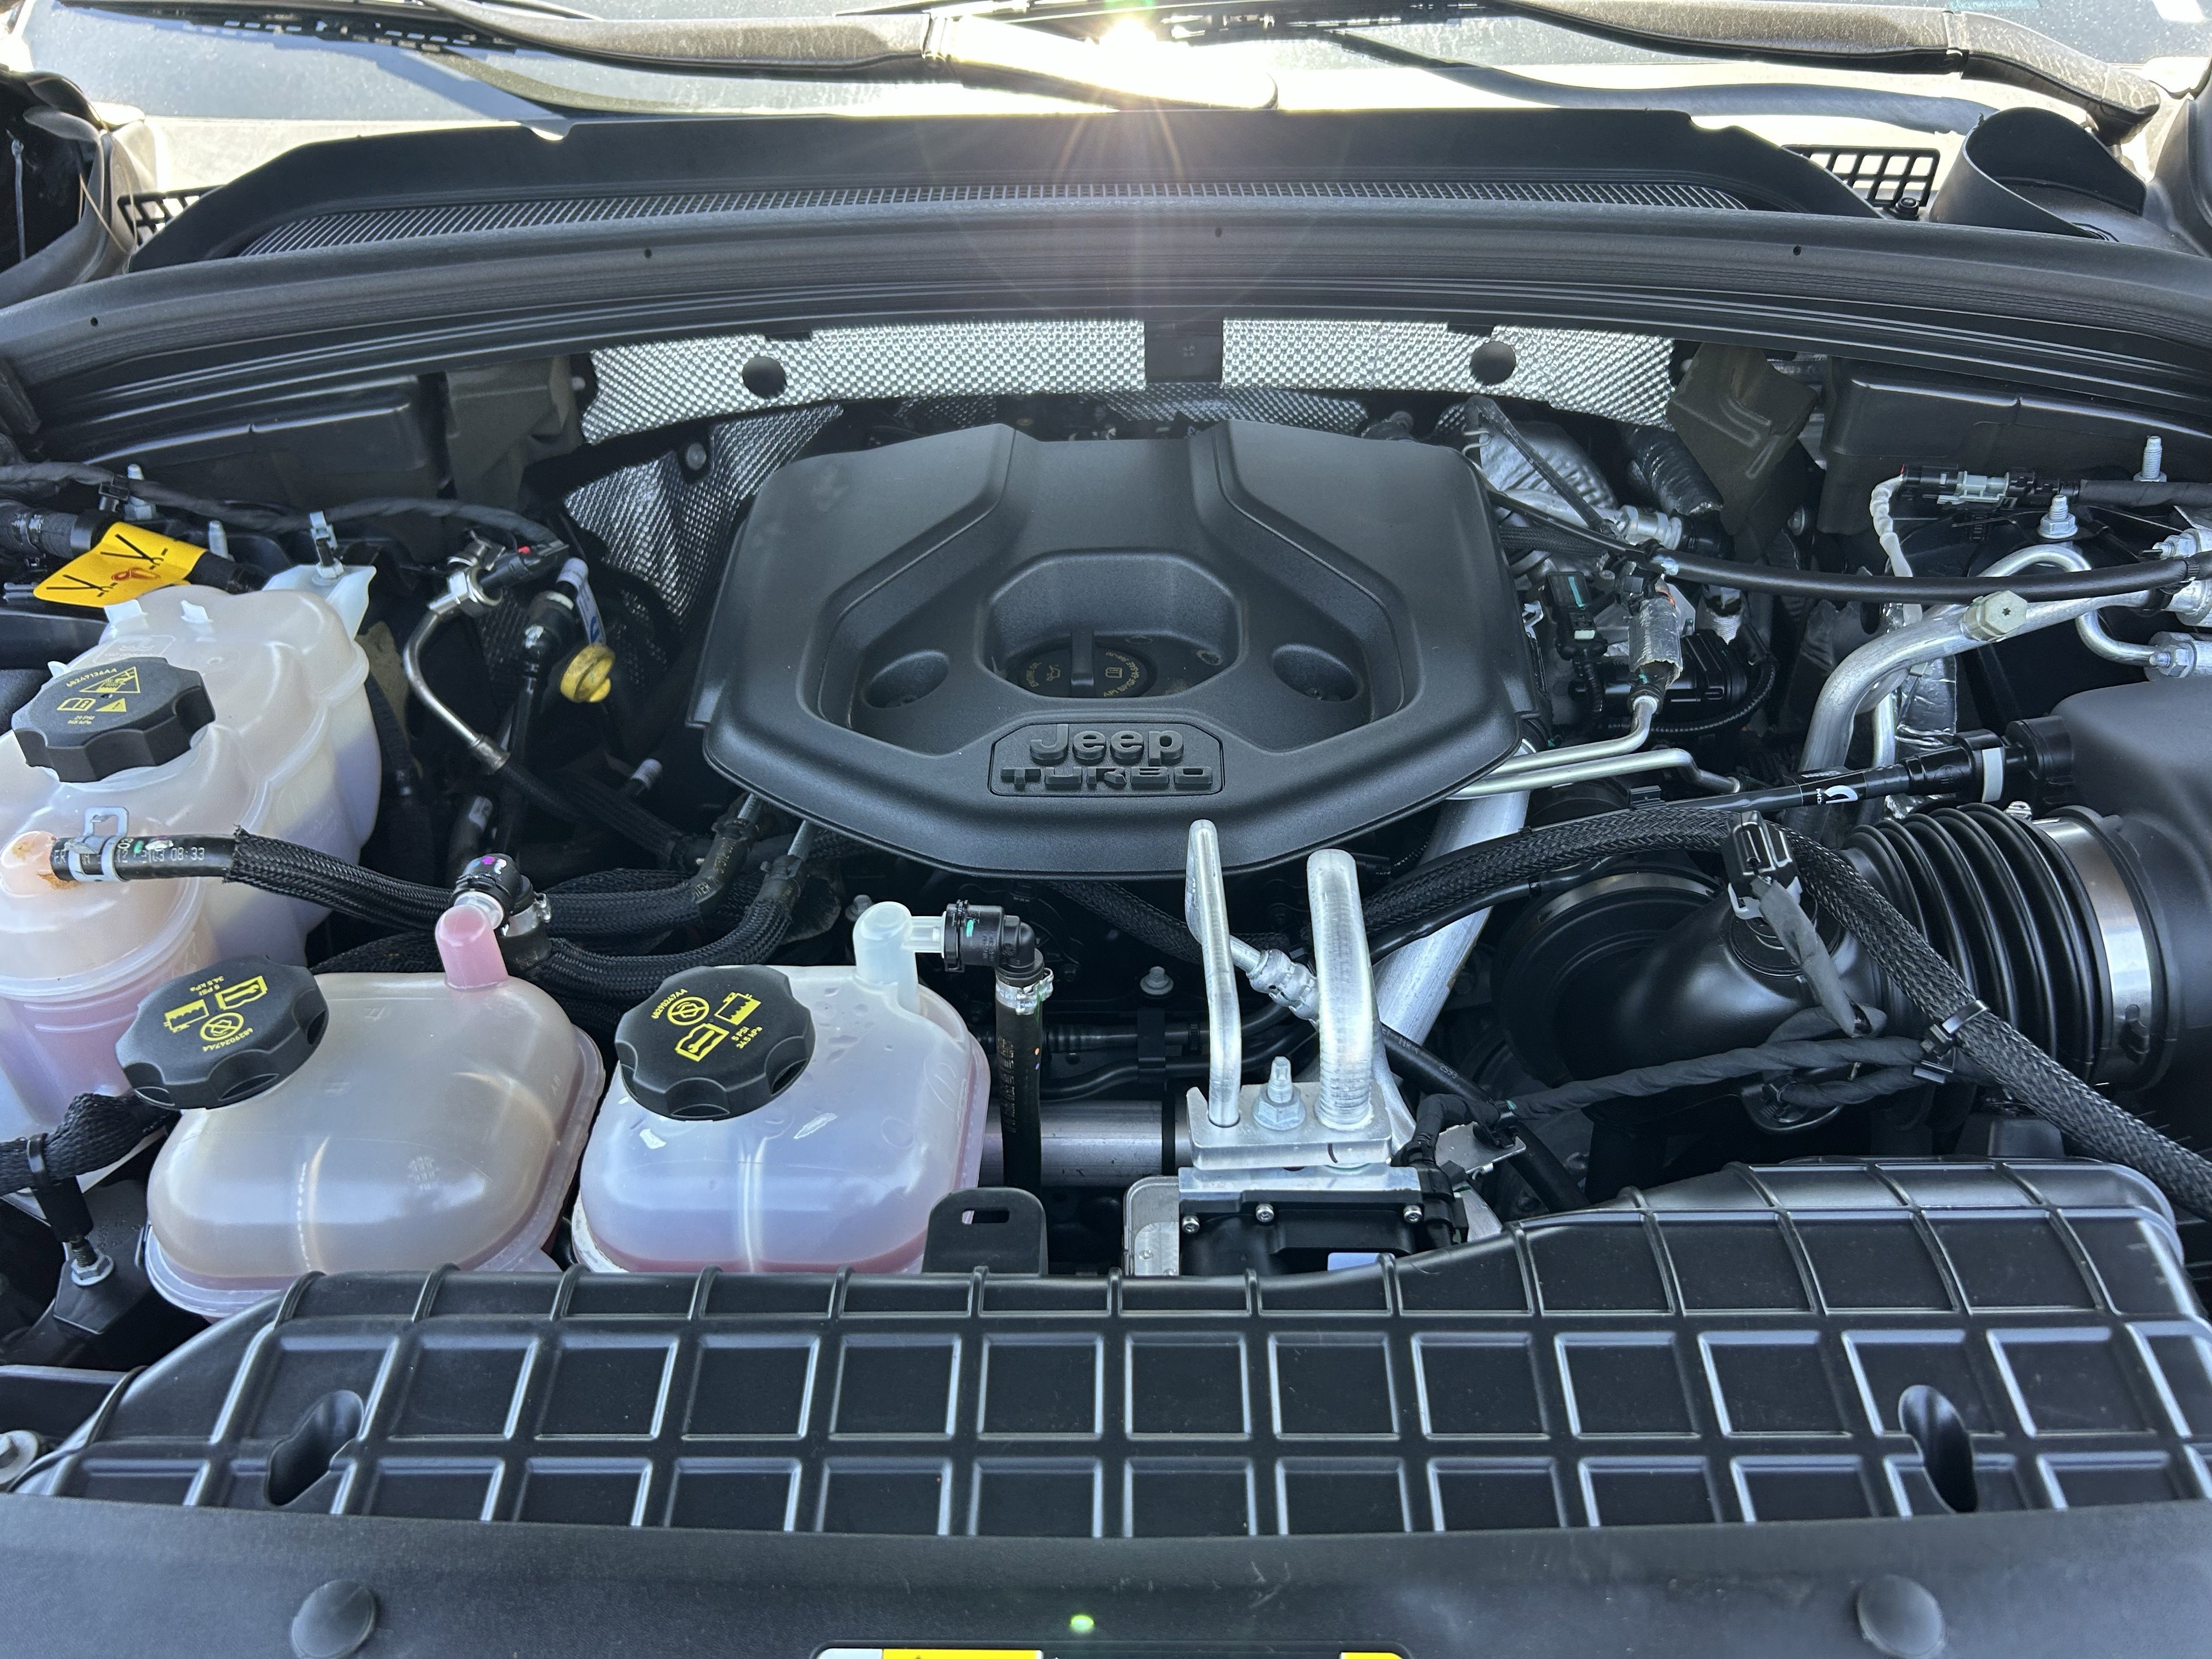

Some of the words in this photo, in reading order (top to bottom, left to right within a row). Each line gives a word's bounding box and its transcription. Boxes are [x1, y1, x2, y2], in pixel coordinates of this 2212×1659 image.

[1103, 689, 1119, 697] API
[1030, 724, 1129, 767] Jeep
[1000, 766, 1214, 791] TURBO
[170, 847, 205, 861] 08:33
[189, 983, 207, 992] kPa
[199, 986, 213, 996] PSI
[651, 988, 688, 1019] 68290247AA
[202, 1027, 253, 1052] 68290247AA
[736, 1026, 750, 1037] PSI
[736, 1037, 752, 1049] 34.5
[748, 1026, 763, 1039] kPa
